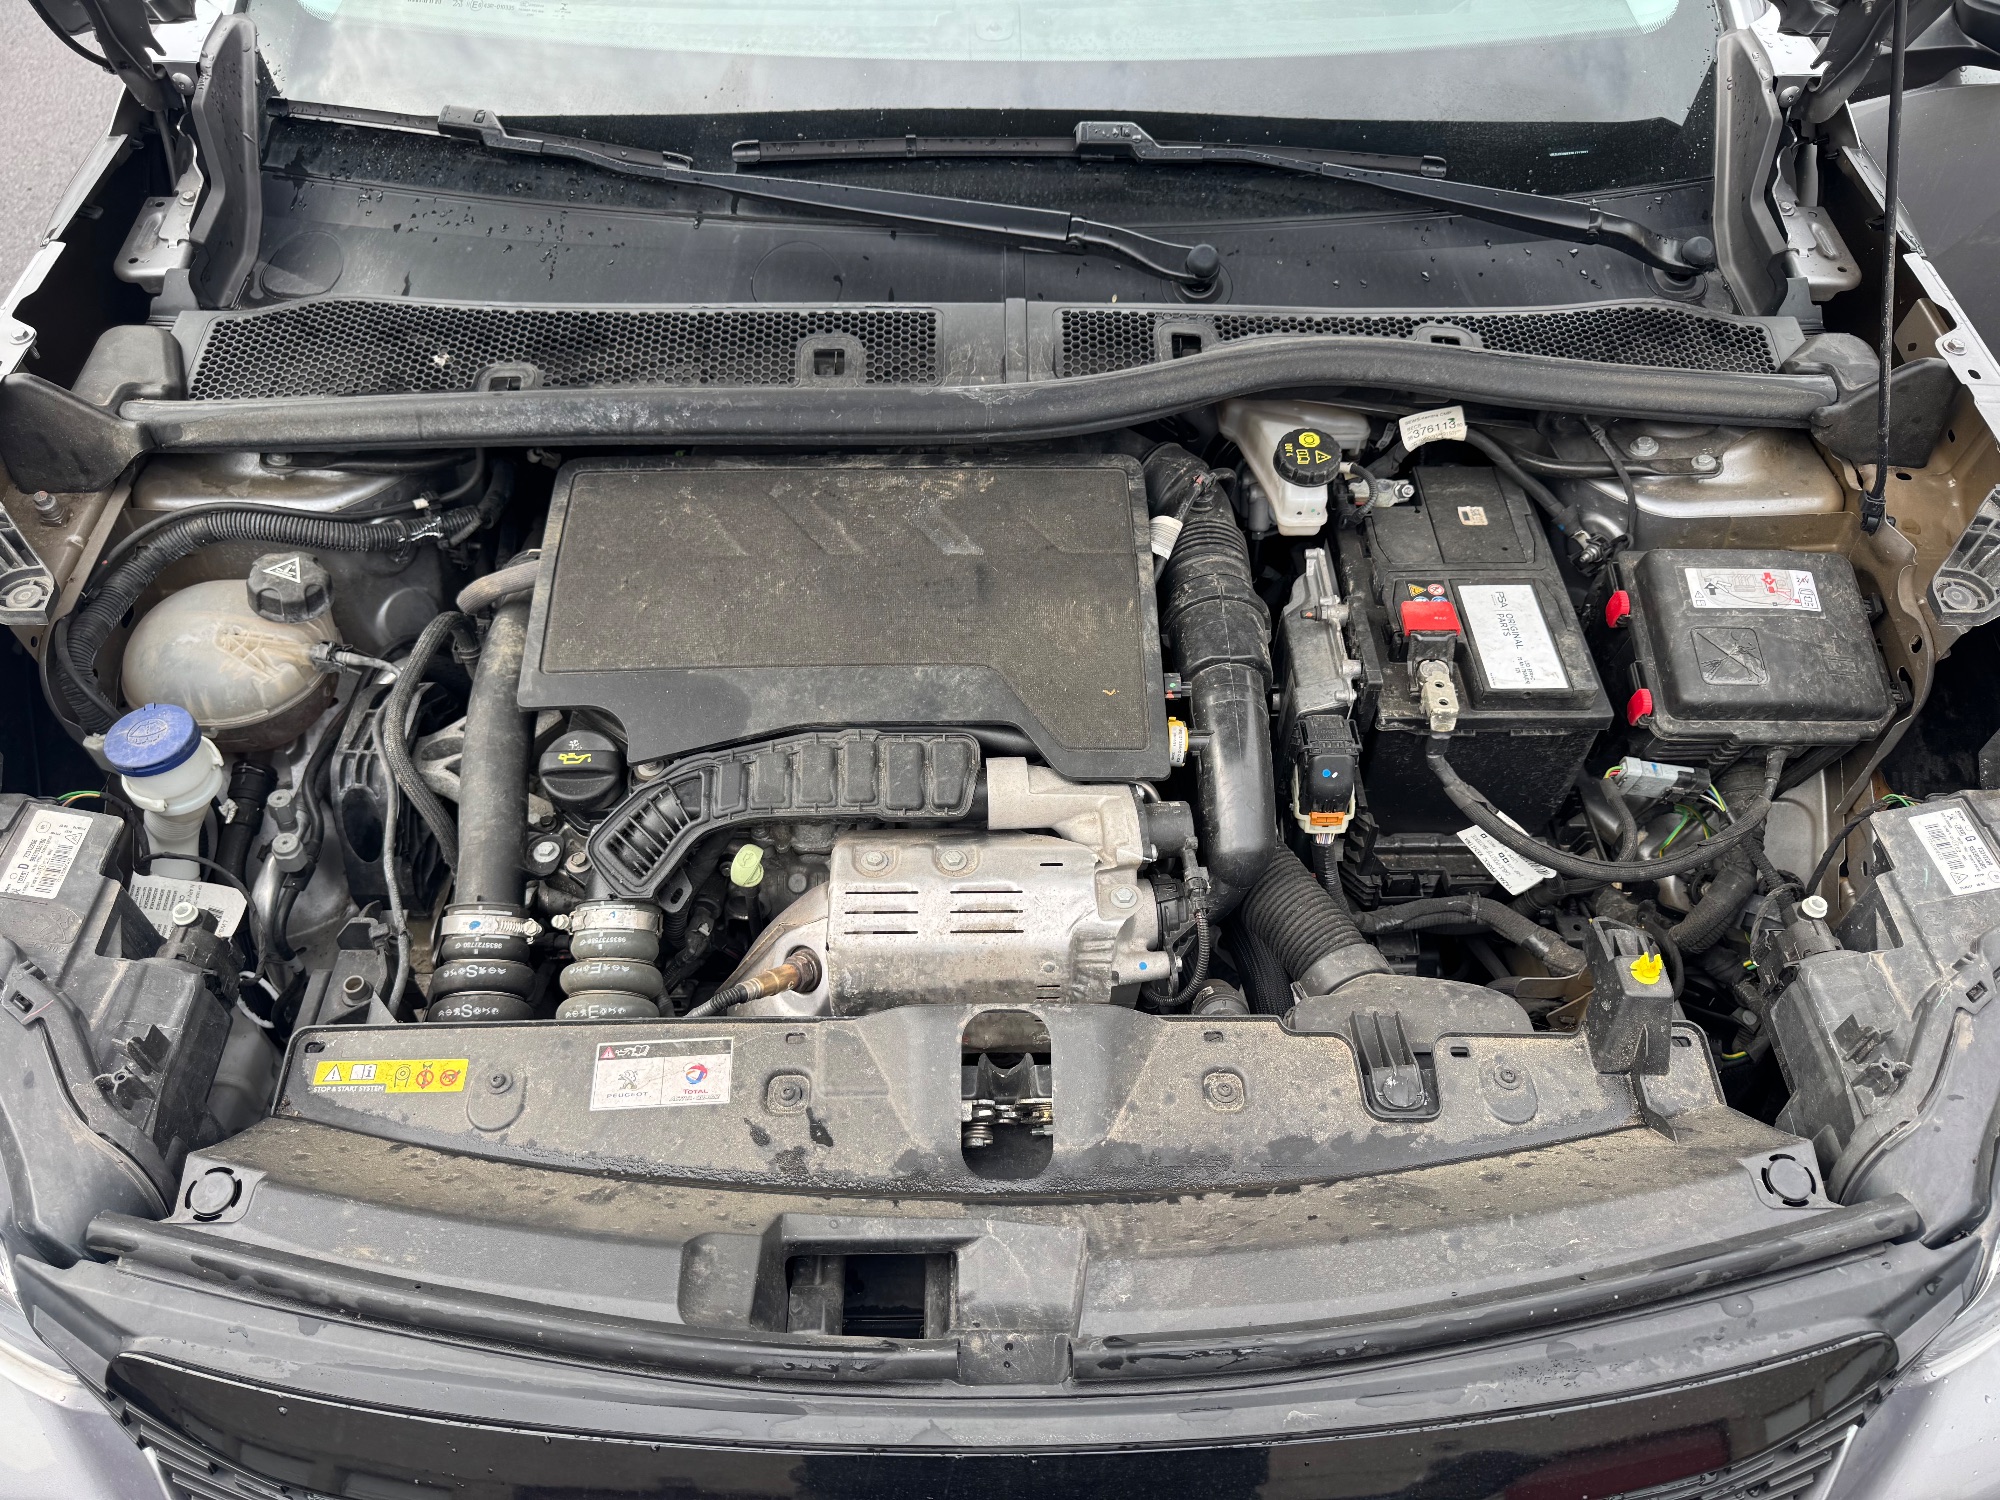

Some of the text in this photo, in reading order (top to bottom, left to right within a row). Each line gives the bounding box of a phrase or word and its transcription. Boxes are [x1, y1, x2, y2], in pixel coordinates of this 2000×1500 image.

[1413, 420, 1457, 439] 376113
[1495, 591, 1509, 609] PSA
[1496, 613, 1511, 637] PARTS
[1505, 613, 1524, 649] ORIGINAL
[461, 1004, 473, 1017] S
[588, 1005, 600, 1018] E
[313, 1085, 331, 1093] STOP
